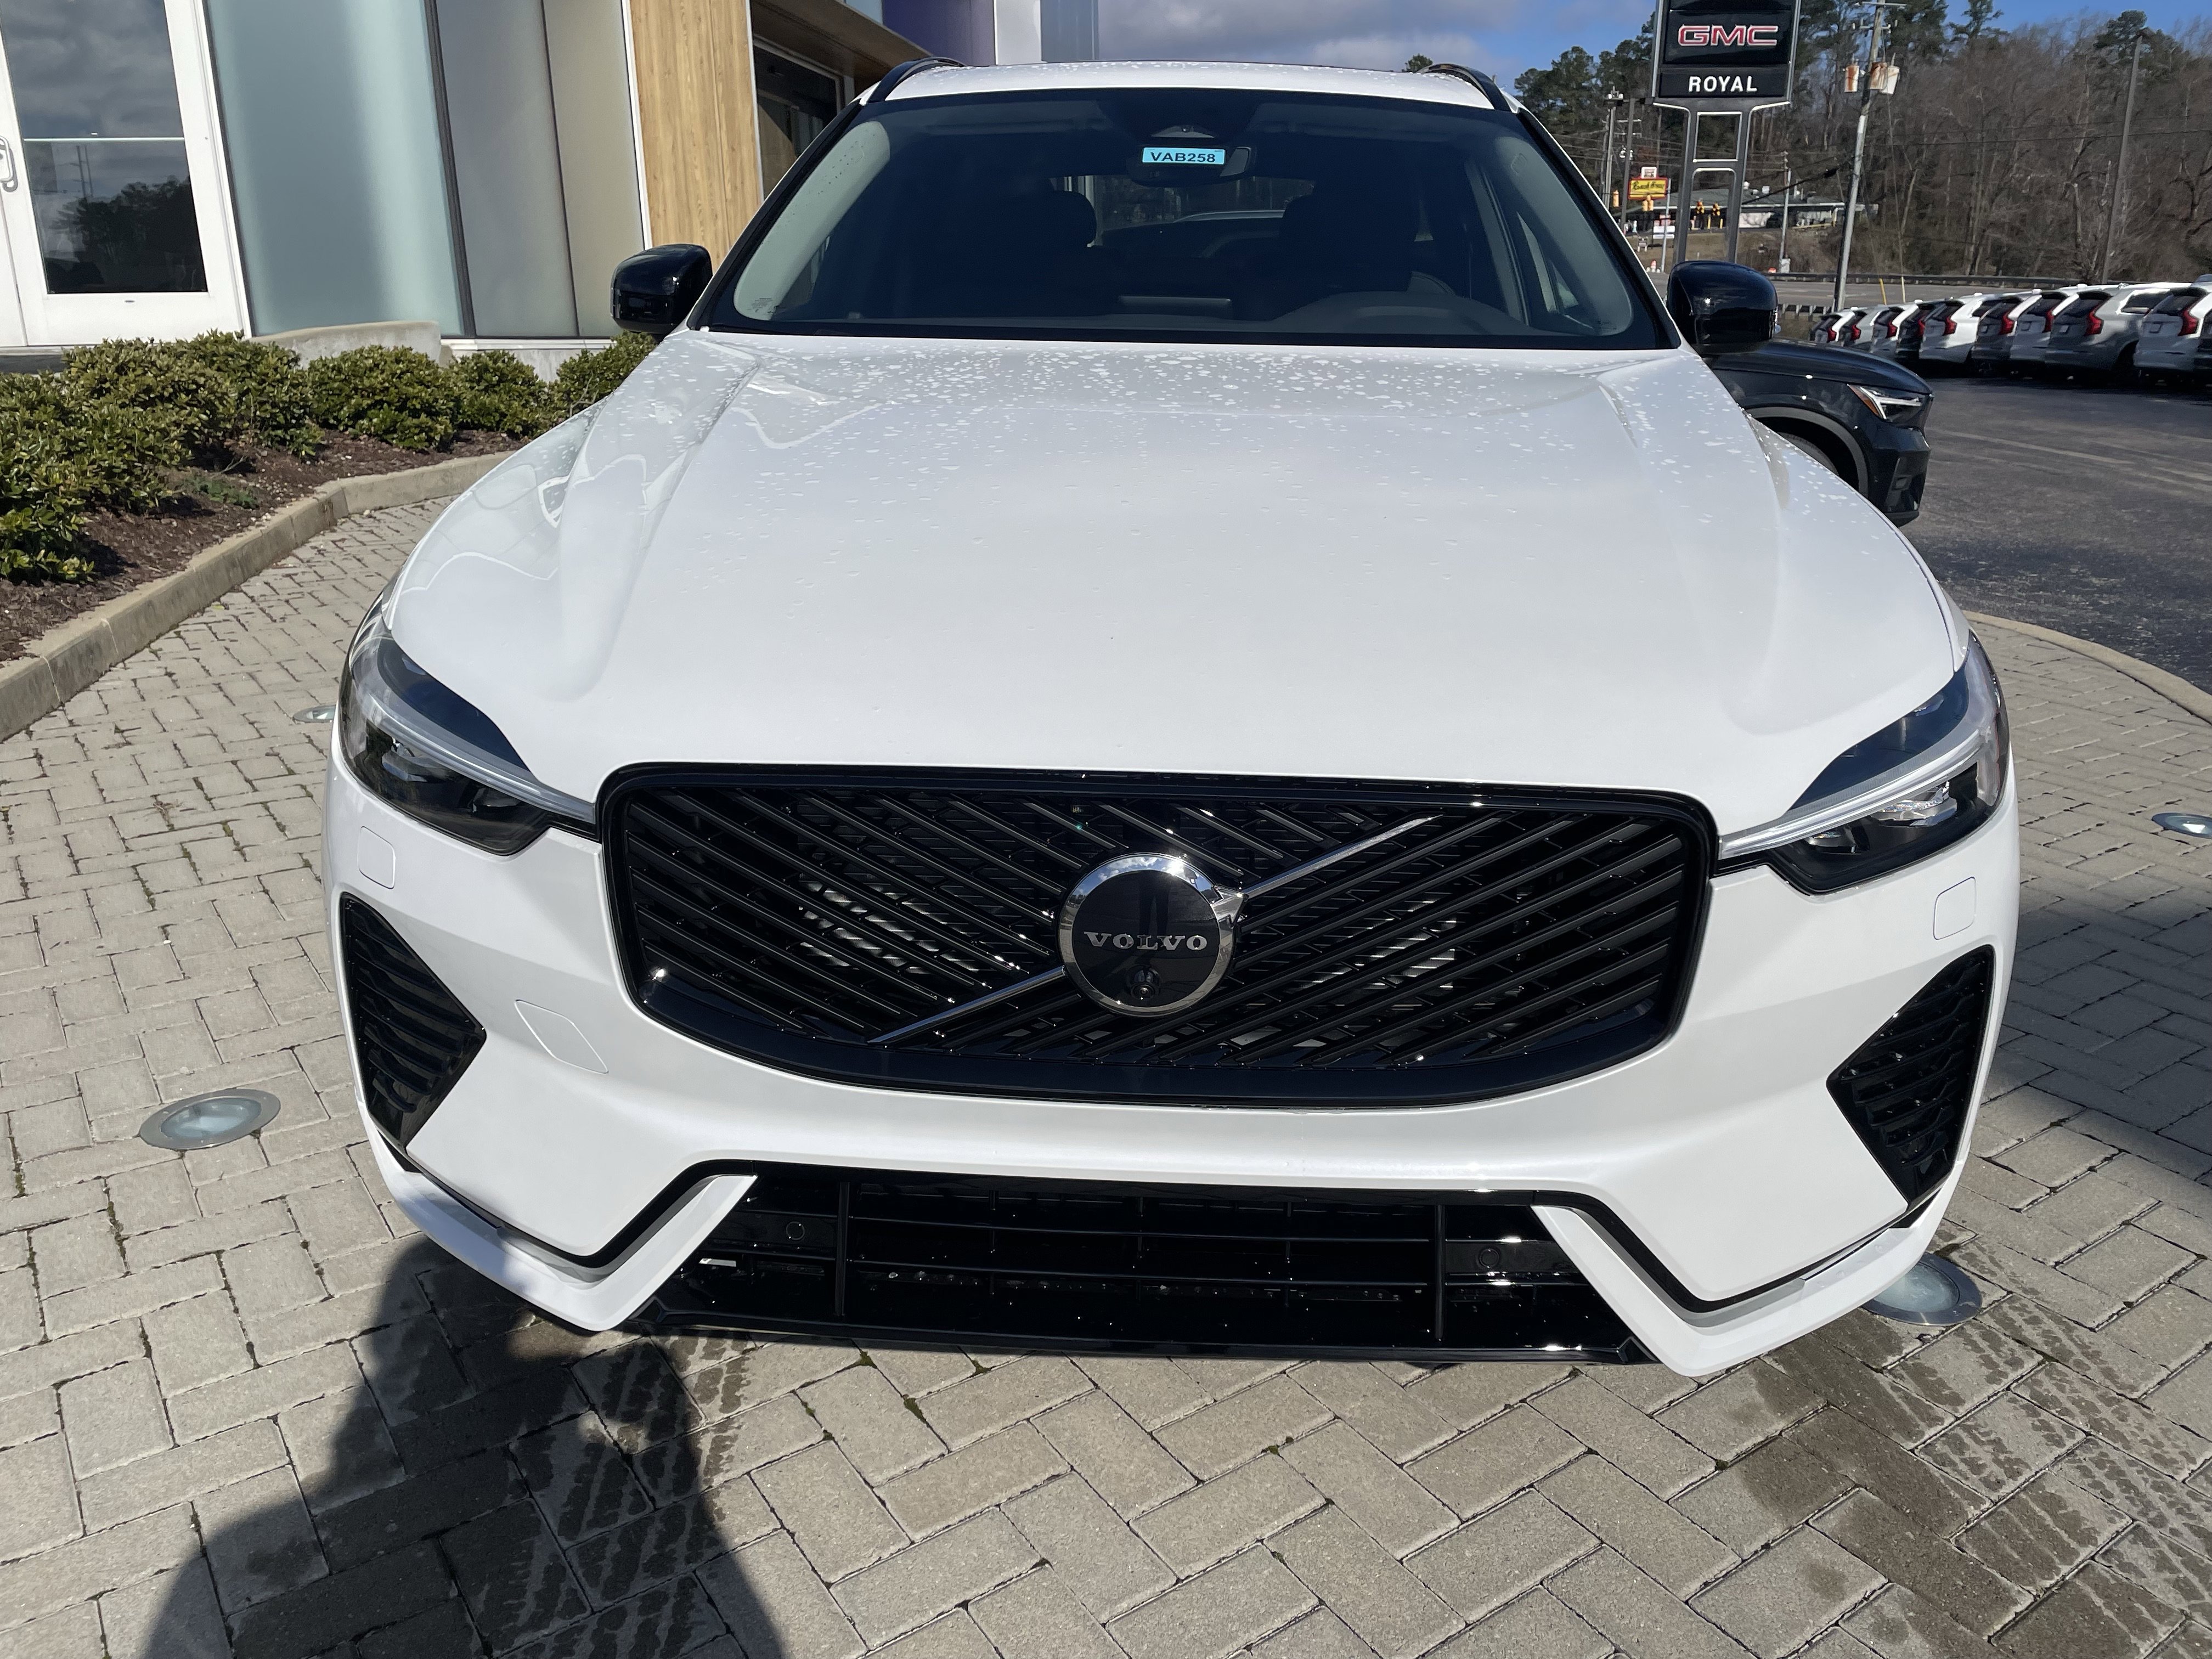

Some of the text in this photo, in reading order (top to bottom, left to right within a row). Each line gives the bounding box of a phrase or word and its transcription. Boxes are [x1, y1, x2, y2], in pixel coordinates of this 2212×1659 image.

[1678, 25, 1778, 46] GMC
[1689, 76, 1757, 92] ROYAL
[1150, 151, 1216, 163] VAB258
[1084, 931, 1207, 951] VOLVO
